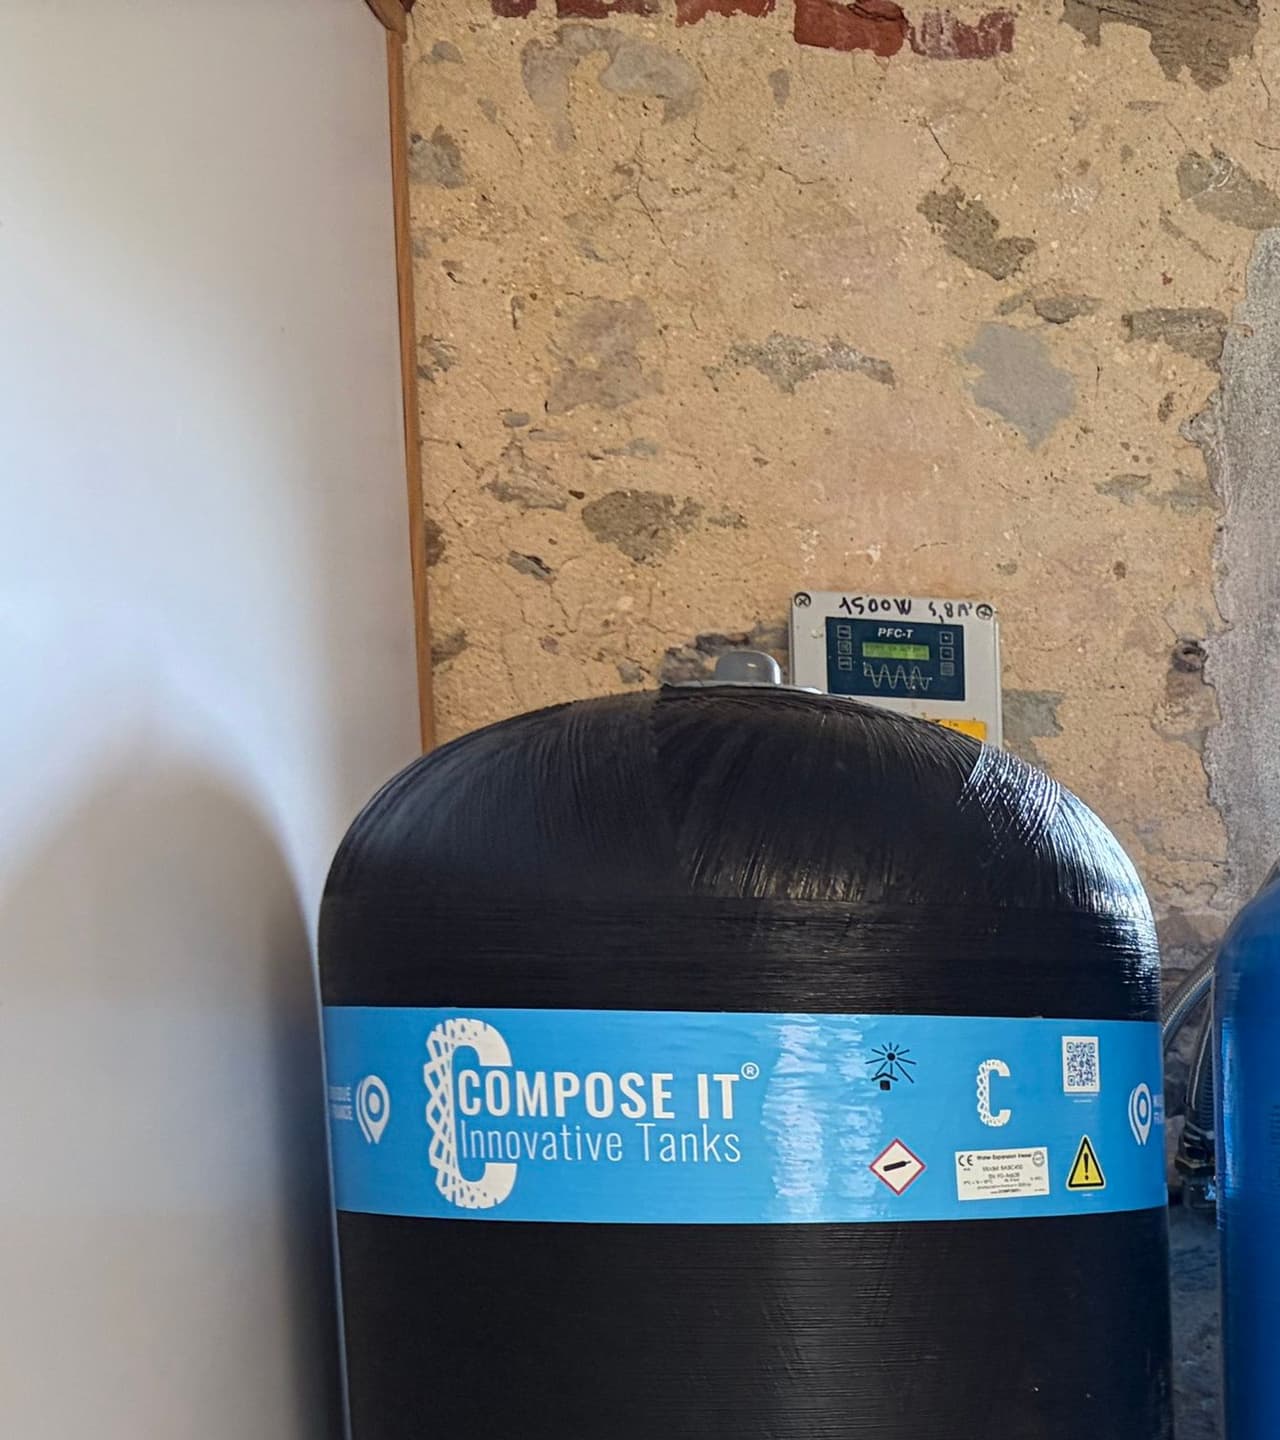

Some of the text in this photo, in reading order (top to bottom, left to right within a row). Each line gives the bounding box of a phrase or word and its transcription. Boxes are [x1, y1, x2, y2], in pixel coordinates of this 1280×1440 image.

[839, 596, 912, 615] 1500W
[877, 627, 914, 639] PFC-T
[457, 1069, 675, 1120] COMPOSE
[460, 1119, 741, 1164] Innovative Tanks
